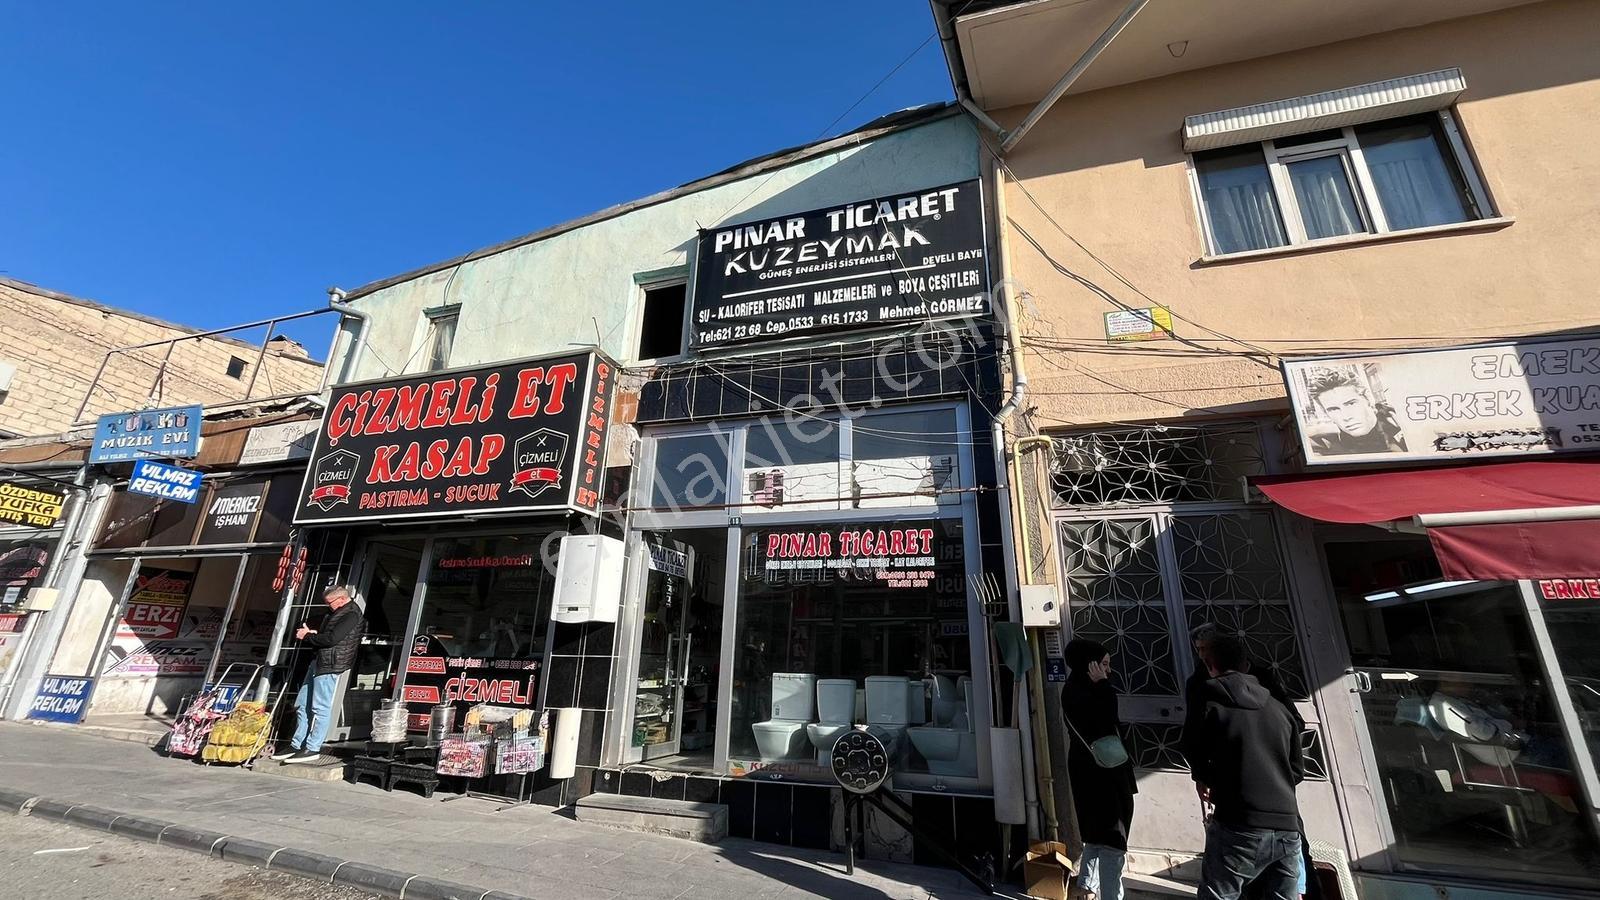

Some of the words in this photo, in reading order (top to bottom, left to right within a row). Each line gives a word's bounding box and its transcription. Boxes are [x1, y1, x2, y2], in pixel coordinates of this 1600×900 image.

[714, 217, 805, 253] PINAR
[826, 187, 959, 232] TİCARET
[724, 224, 931, 277] KUZEYMAK
[759, 267, 793, 280] GÜNEŞ
[795, 260, 838, 275] ENERJİSİ
[839, 252, 896, 268] SİSTEMLERİ
[699, 310, 710, 323] SU
[718, 299, 765, 320] KALORİFER
[766, 293, 805, 313] TESİSATI
[813, 283, 877, 306] MALZEMELERİ
[881, 285, 892, 297] ve
[898, 279, 926, 295] BOYA
[928, 269, 980, 292] ÇEŞİTLERİ
[734, 325, 746, 338] 23
[748, 323, 761, 335] 68
[820, 312, 840, 325] 615
[843, 309, 869, 323] 1733
[879, 303, 927, 320] Mehmet
[930, 296, 983, 314] GÖRMEZ
[1471, 348, 1600, 380] EMEK
[327, 372, 501, 447] ÇİZMELİ
[508, 362, 577, 420] ET
[1405, 390, 1523, 422] ERKEK
[584, 362, 610, 484] ÇİZMELİ
[101, 432, 154, 449] MÜZİK
[161, 428, 190, 444] EVİ
[366, 433, 505, 484] KASAP
[519, 450, 559, 466] ÇİZMELİ
[140, 464, 197, 486] YILMAZ
[318, 468, 352, 483] ÇİZMELİ
[530, 467, 541, 479] et
[0, 483, 62, 505] ÖZDEVELİ
[131, 477, 196, 500] REKLAM
[325, 486, 335, 496] et
[359, 487, 429, 510] PASTIRMA
[444, 483, 501, 503] SUCUK
[576, 487, 598, 508] ET
[0, 496, 55, 514] YUFKA
[216, 495, 260, 514] MERKEZ
[767, 532, 831, 557] PINAR
[839, 529, 934, 556] TİCARET
[1539, 578, 1600, 600] ERKE
[124, 604, 182, 624] TERZİ
[131, 655, 196, 665] REKLAM
[42, 680, 86, 694] YILMAZ
[445, 671, 535, 705] ÇİZMELİ
[33, 698, 83, 714] REKLAM
